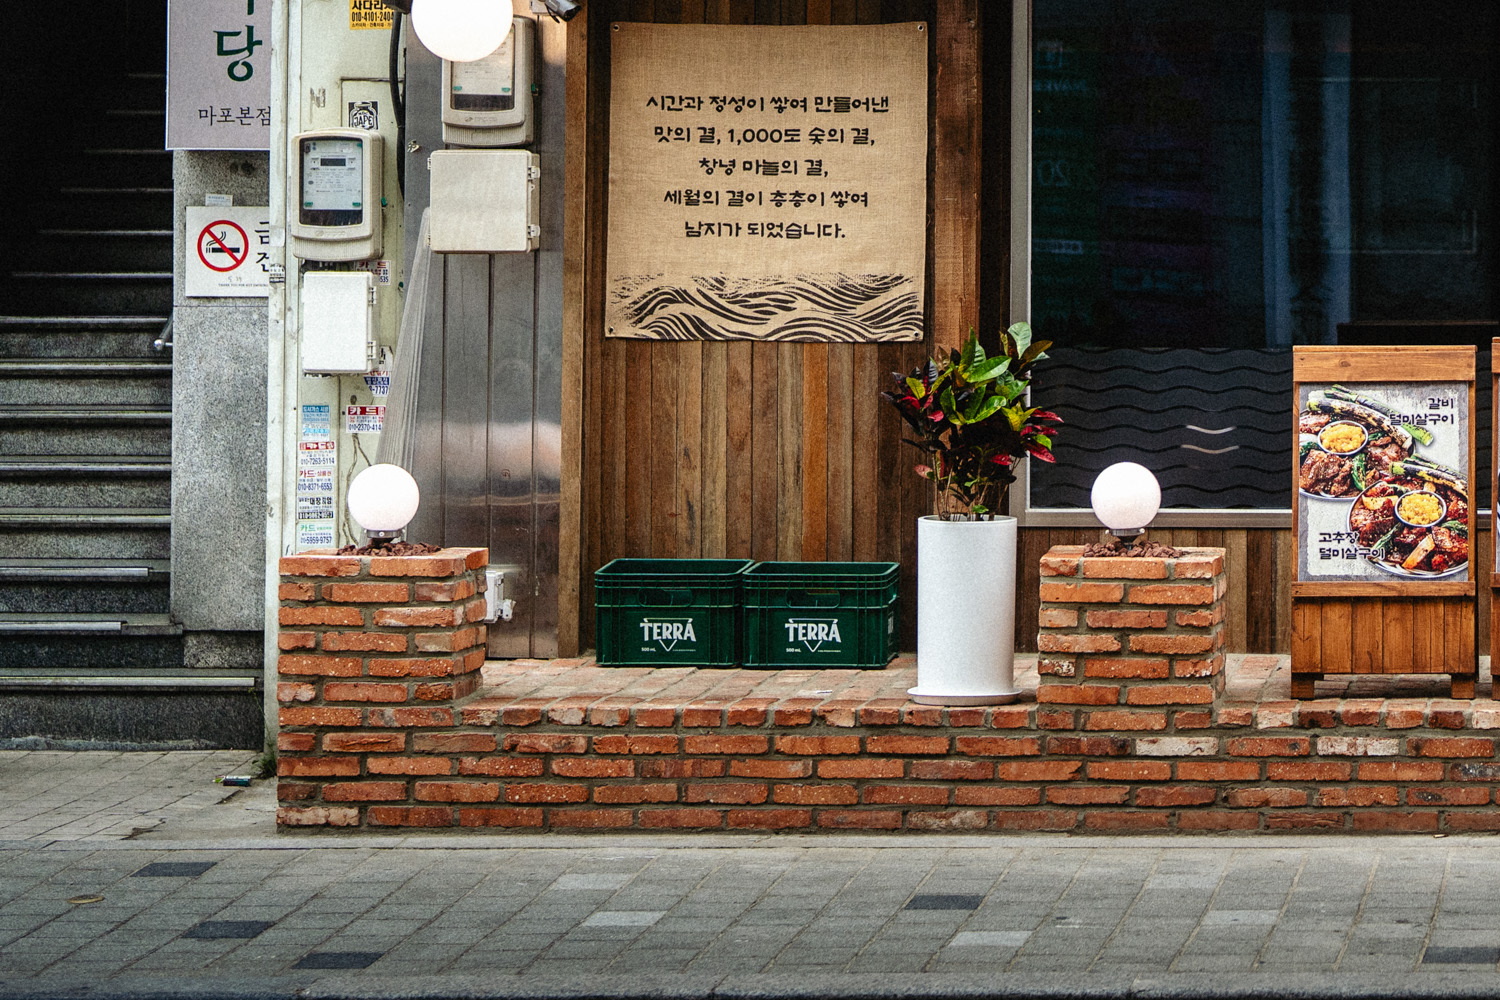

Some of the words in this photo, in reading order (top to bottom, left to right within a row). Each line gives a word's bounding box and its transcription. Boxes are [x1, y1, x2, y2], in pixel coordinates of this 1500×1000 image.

[646, 95, 704, 112] 시간과
[709, 95, 765, 113] 정성이
[769, 95, 808, 114] 쌓여
[814, 95, 889, 113] 만들어낸
[198, 105, 271, 127] 마포본점
[654, 127, 691, 143] 맛의
[698, 126, 721, 145] 결,
[727, 127, 801, 145] 1,000도
[808, 127, 844, 145] 숯의
[850, 127, 875, 146] 결,
[699, 157, 736, 176] 창녕
[742, 158, 798, 176] 마늘의
[804, 158, 828, 178] 결,
[664, 189, 720, 206] 세월의
[726, 190, 763, 206] 결이
[769, 190, 825, 207] 층층이
[830, 190, 868, 208] 쌓여
[685, 221, 742, 238] 남지가
[747, 222, 846, 239] 되었습니다.
[1428, 397, 1454, 409] 갈비
[1389, 412, 1454, 426] 덜미살구이
[1318, 531, 1359, 545] 고추장
[1318, 546, 1386, 560] 덜미살구이
[640, 620, 697, 642] TERRA
[785, 622, 842, 643] TERRA
